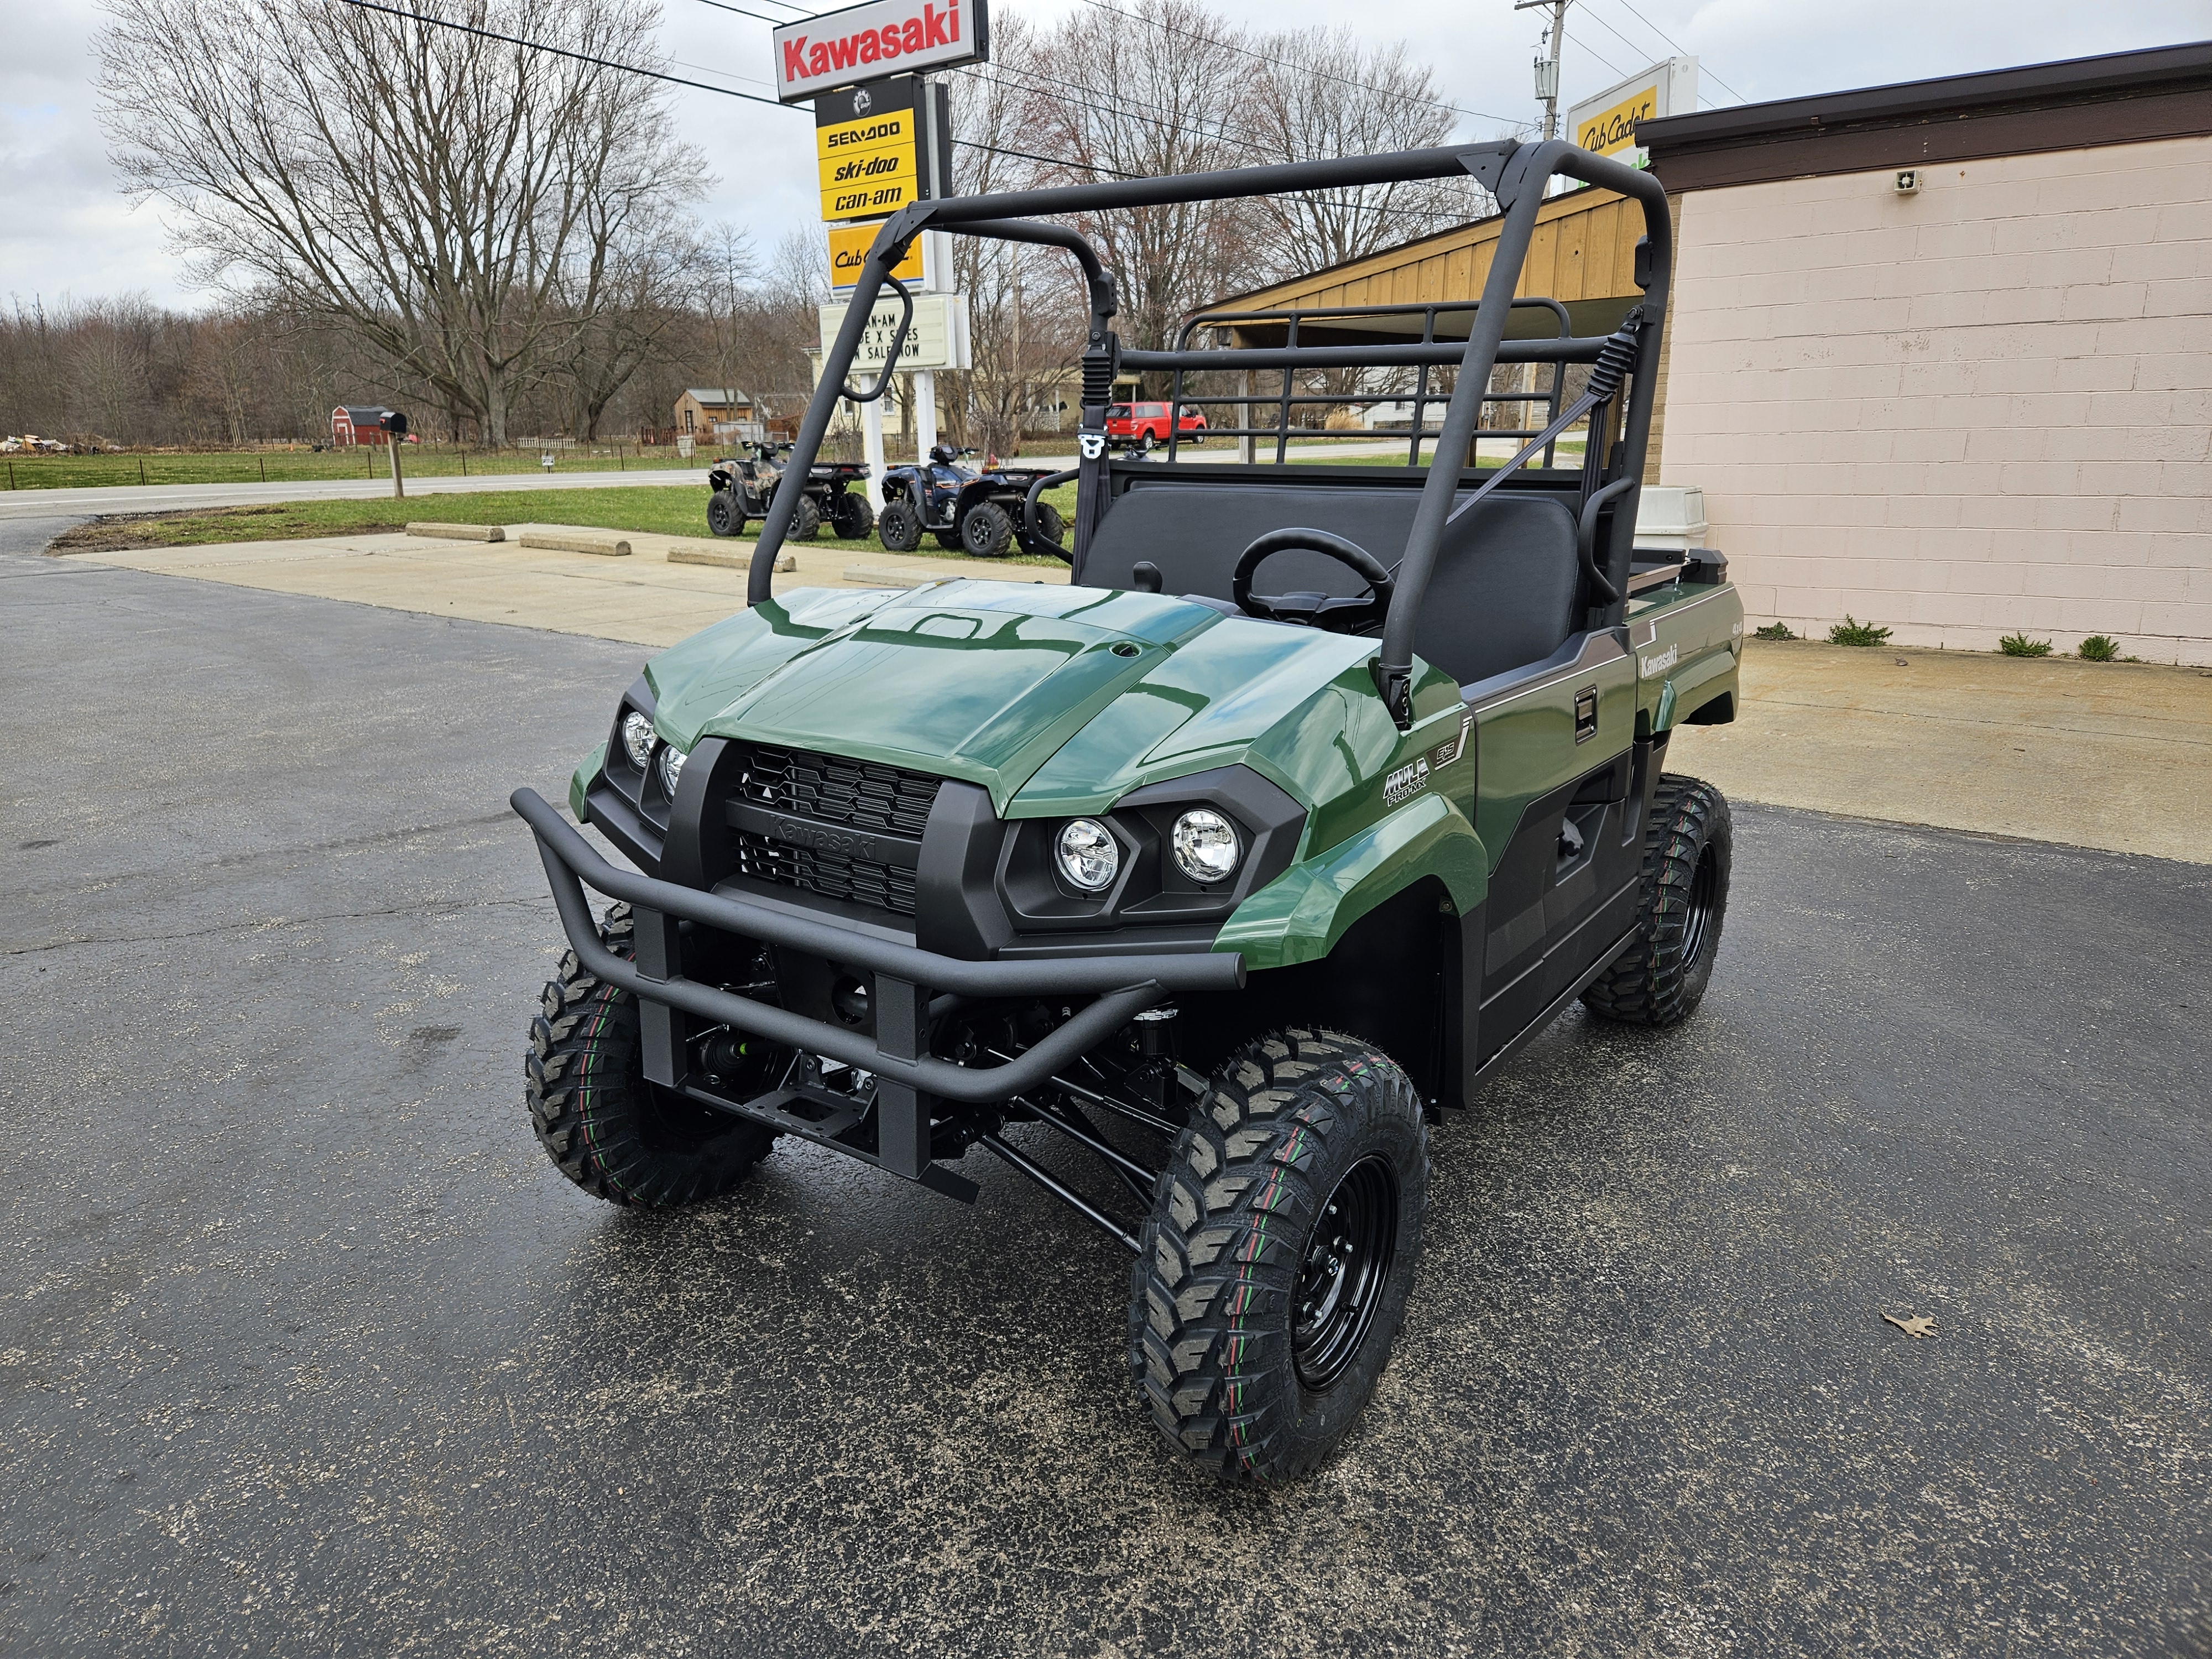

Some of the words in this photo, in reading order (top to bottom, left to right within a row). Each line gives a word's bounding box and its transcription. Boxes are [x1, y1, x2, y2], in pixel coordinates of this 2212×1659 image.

[784, 0, 960, 82] Kawasaki
[834, 157, 899, 181] ski-doo
[835, 187, 902, 211] can-am
[835, 249, 862, 268] Cub
[866, 314, 895, 328] AN-AM
[877, 331, 883, 343] X
[1641, 643, 1677, 679] Kawasaki
[1437, 742, 1454, 760] EPS
[1383, 758, 1430, 799] MULE
[1387, 778, 1426, 807] PRO-MX
[770, 815, 876, 860] Kawasaki
